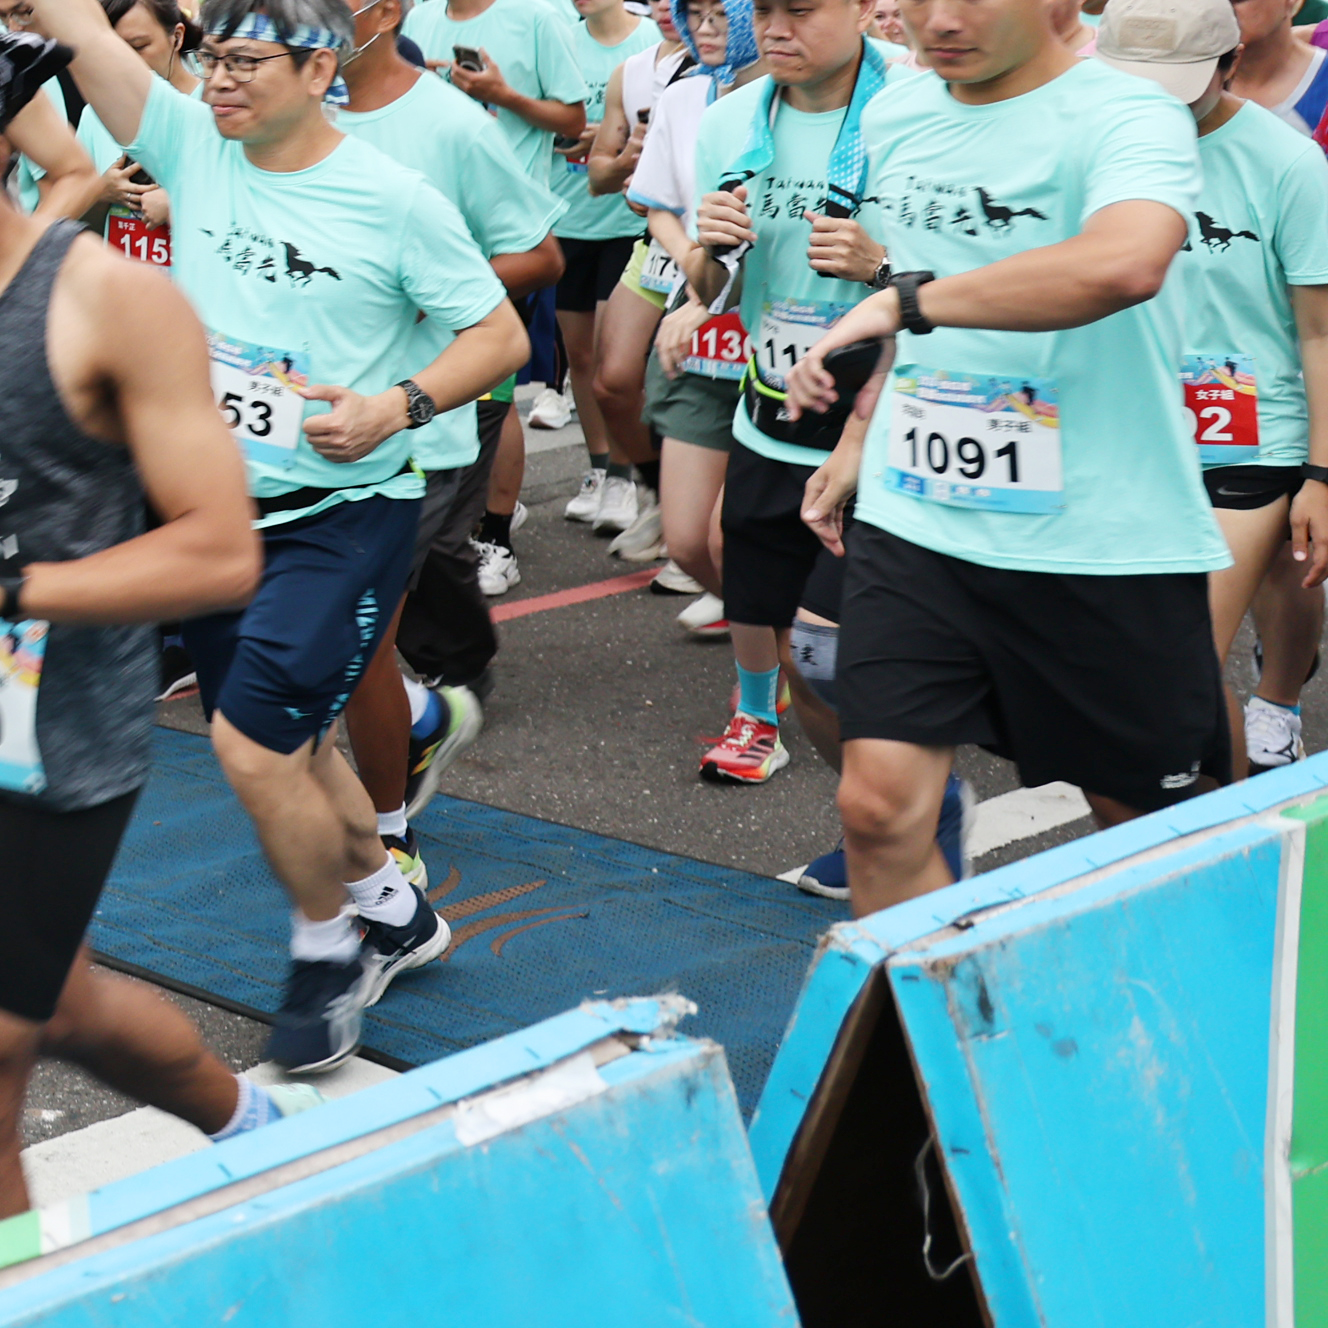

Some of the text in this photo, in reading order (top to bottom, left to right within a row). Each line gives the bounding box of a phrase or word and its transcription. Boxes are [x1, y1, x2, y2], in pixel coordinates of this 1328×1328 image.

[120, 233, 176, 264] 115
[1195, 389, 1235, 401] 女子組
[904, 426, 1021, 483] 1091
